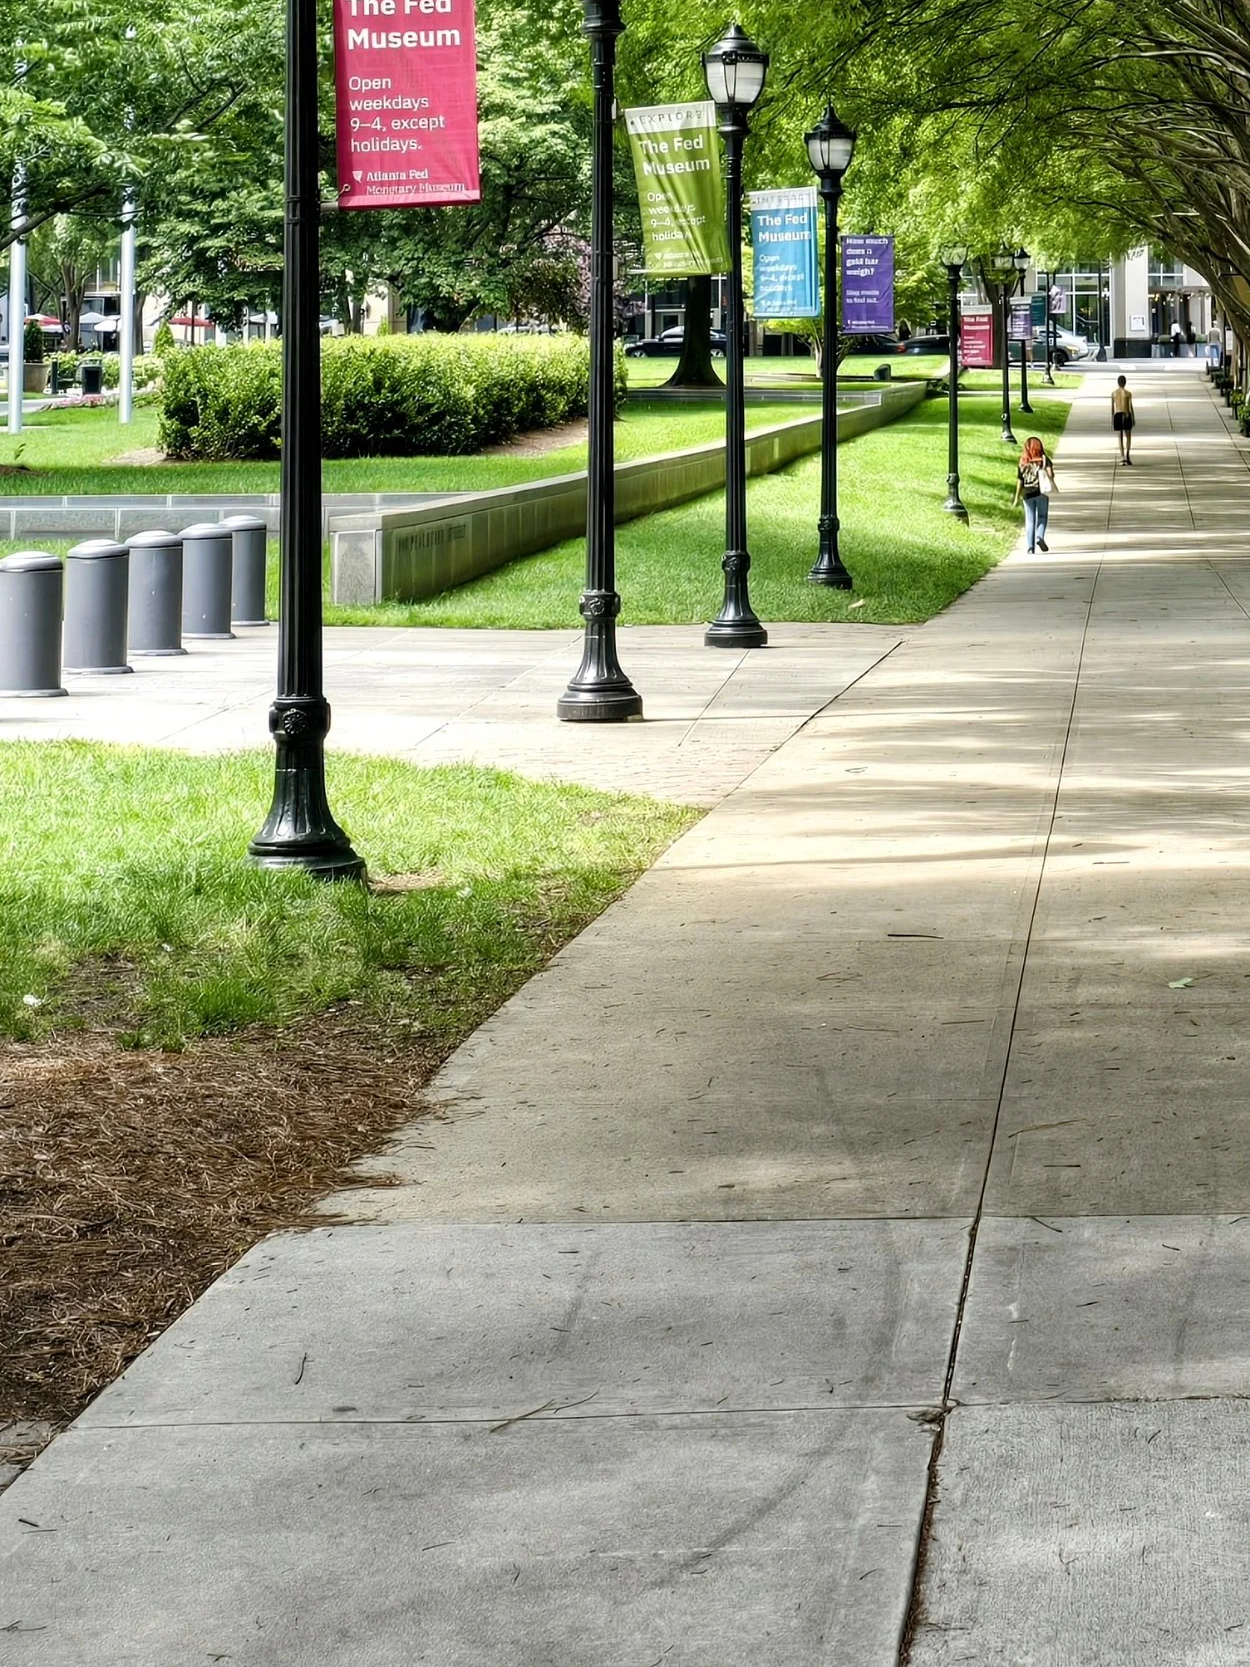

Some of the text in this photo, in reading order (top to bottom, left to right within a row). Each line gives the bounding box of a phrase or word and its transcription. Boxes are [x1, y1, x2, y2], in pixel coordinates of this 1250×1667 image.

[347, 28, 461, 50] Museum
[348, 76, 392, 93] Open
[350, 95, 429, 111] weekdays
[391, 115, 445, 131] except
[351, 137, 423, 153] holidays.
[639, 134, 704, 155] The Fed
[409, 169, 429, 180] Fed
[642, 159, 710, 176] Museum
[757, 212, 808, 227] The Fed
[758, 230, 810, 243] Museum
